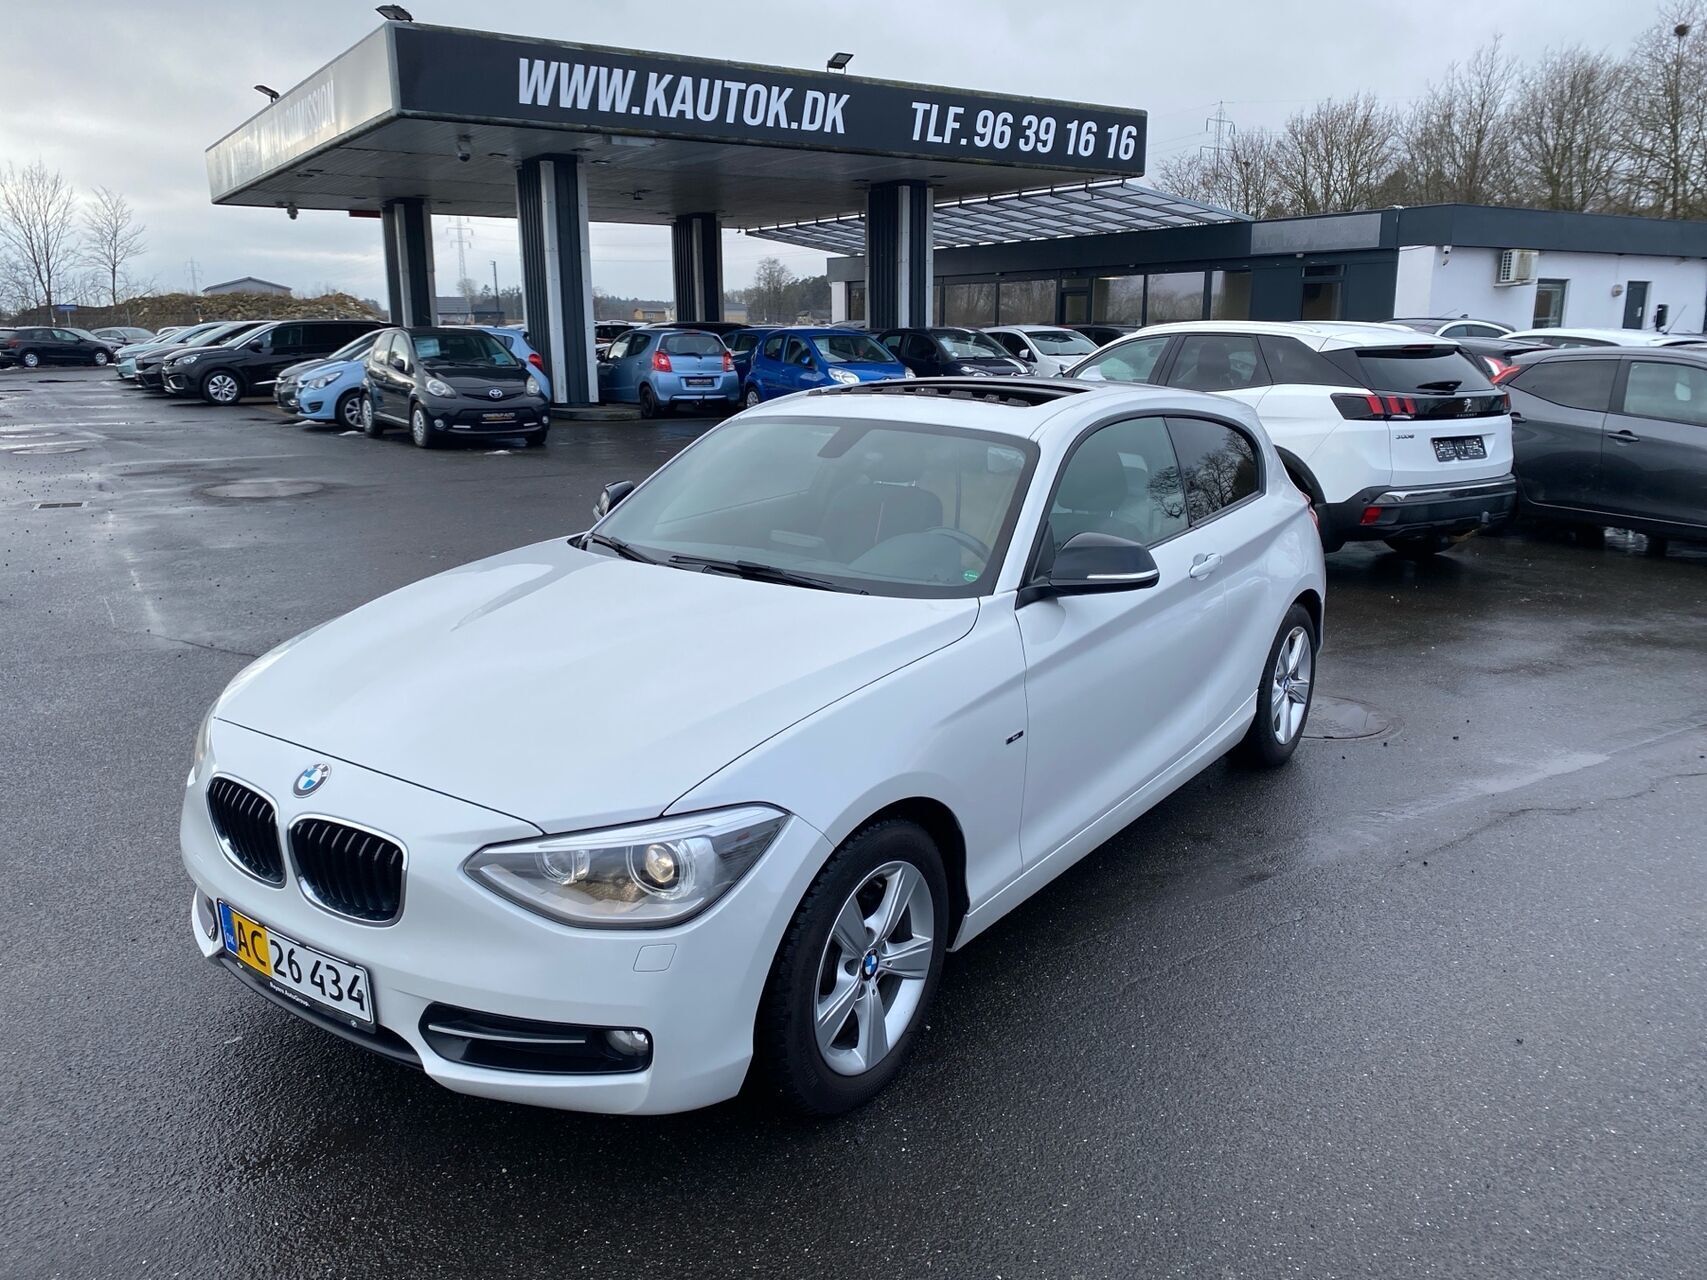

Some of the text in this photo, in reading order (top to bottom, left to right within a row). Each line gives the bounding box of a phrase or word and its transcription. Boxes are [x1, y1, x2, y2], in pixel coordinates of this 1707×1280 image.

[518, 57, 851, 135] WWW.KAUTOK.DK
[911, 101, 1138, 161] TLF. 96 39 16 16
[237, 920, 267, 967] AC
[269, 938, 303, 985] 26
[310, 959, 366, 1012] 434
